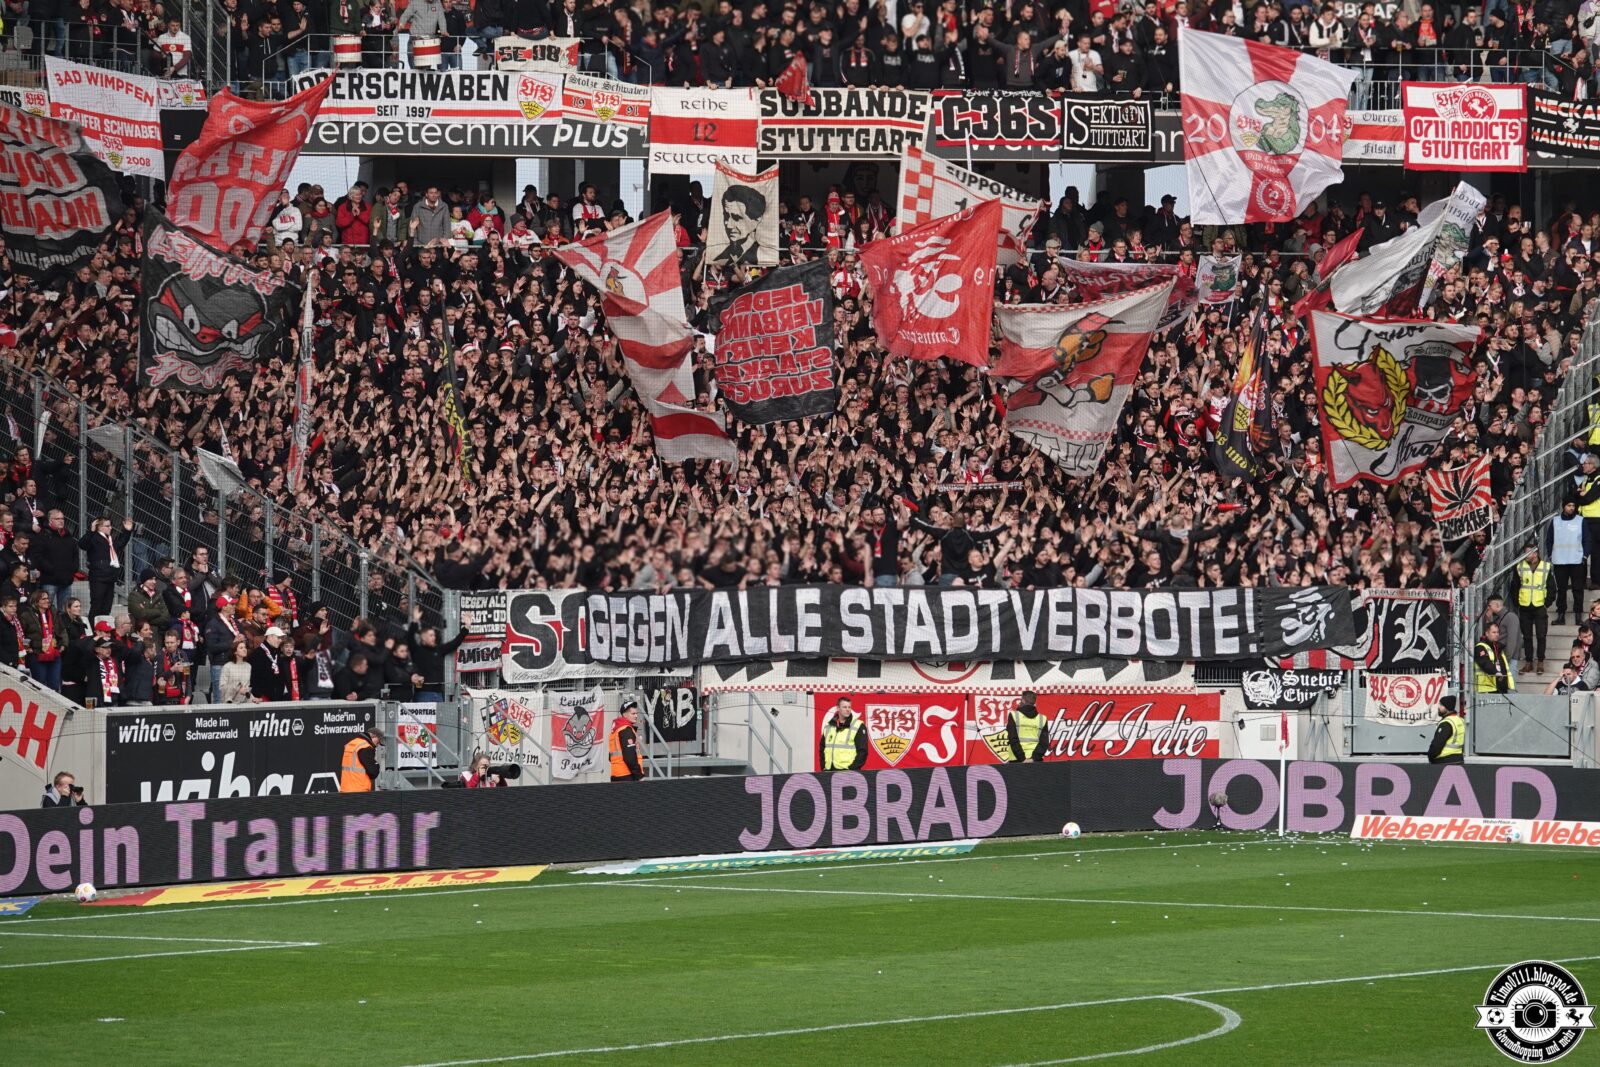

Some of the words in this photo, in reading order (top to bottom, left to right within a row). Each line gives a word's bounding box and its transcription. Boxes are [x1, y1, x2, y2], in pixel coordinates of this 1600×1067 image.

[84, 71, 155, 107] WIMPFEN
[601, 80, 648, 97] Schwaben
[377, 105, 399, 118] SEIT
[406, 105, 432, 119] 1997
[104, 119, 162, 141] SCHWABEN
[553, 124, 629, 148] PLUS
[692, 122, 718, 143] 12
[1185, 113, 1228, 145] 20
[1413, 119, 1446, 139] 0711
[1451, 121, 1520, 141] ADDICTS
[1531, 126, 1600, 151] HALUNKE
[1422, 140, 1510, 160] STUTTGART
[127, 156, 151, 167] 2008
[587, 593, 691, 664] GEGEN
[703, 590, 822, 660] ALLE
[195, 718, 218, 728] Made
[219, 718, 230, 728] im
[323, 712, 345, 723] Made
[346, 712, 356, 722] im
[1377, 703, 1433, 725] Stuttgart
[119, 718, 162, 743] wiha
[186, 728, 239, 741] Schwarzwald
[250, 713, 290, 738] wiha
[314, 721, 365, 735] Schwarzwald
[1152, 704, 1208, 758] die
[1152, 758, 1558, 833] JOBRAD
[738, 764, 1008, 851] JOBRAD
[1359, 815, 1512, 843] WeberHaus
[0, 807, 140, 894] Dein
[306, 869, 500, 890] LOTTO
